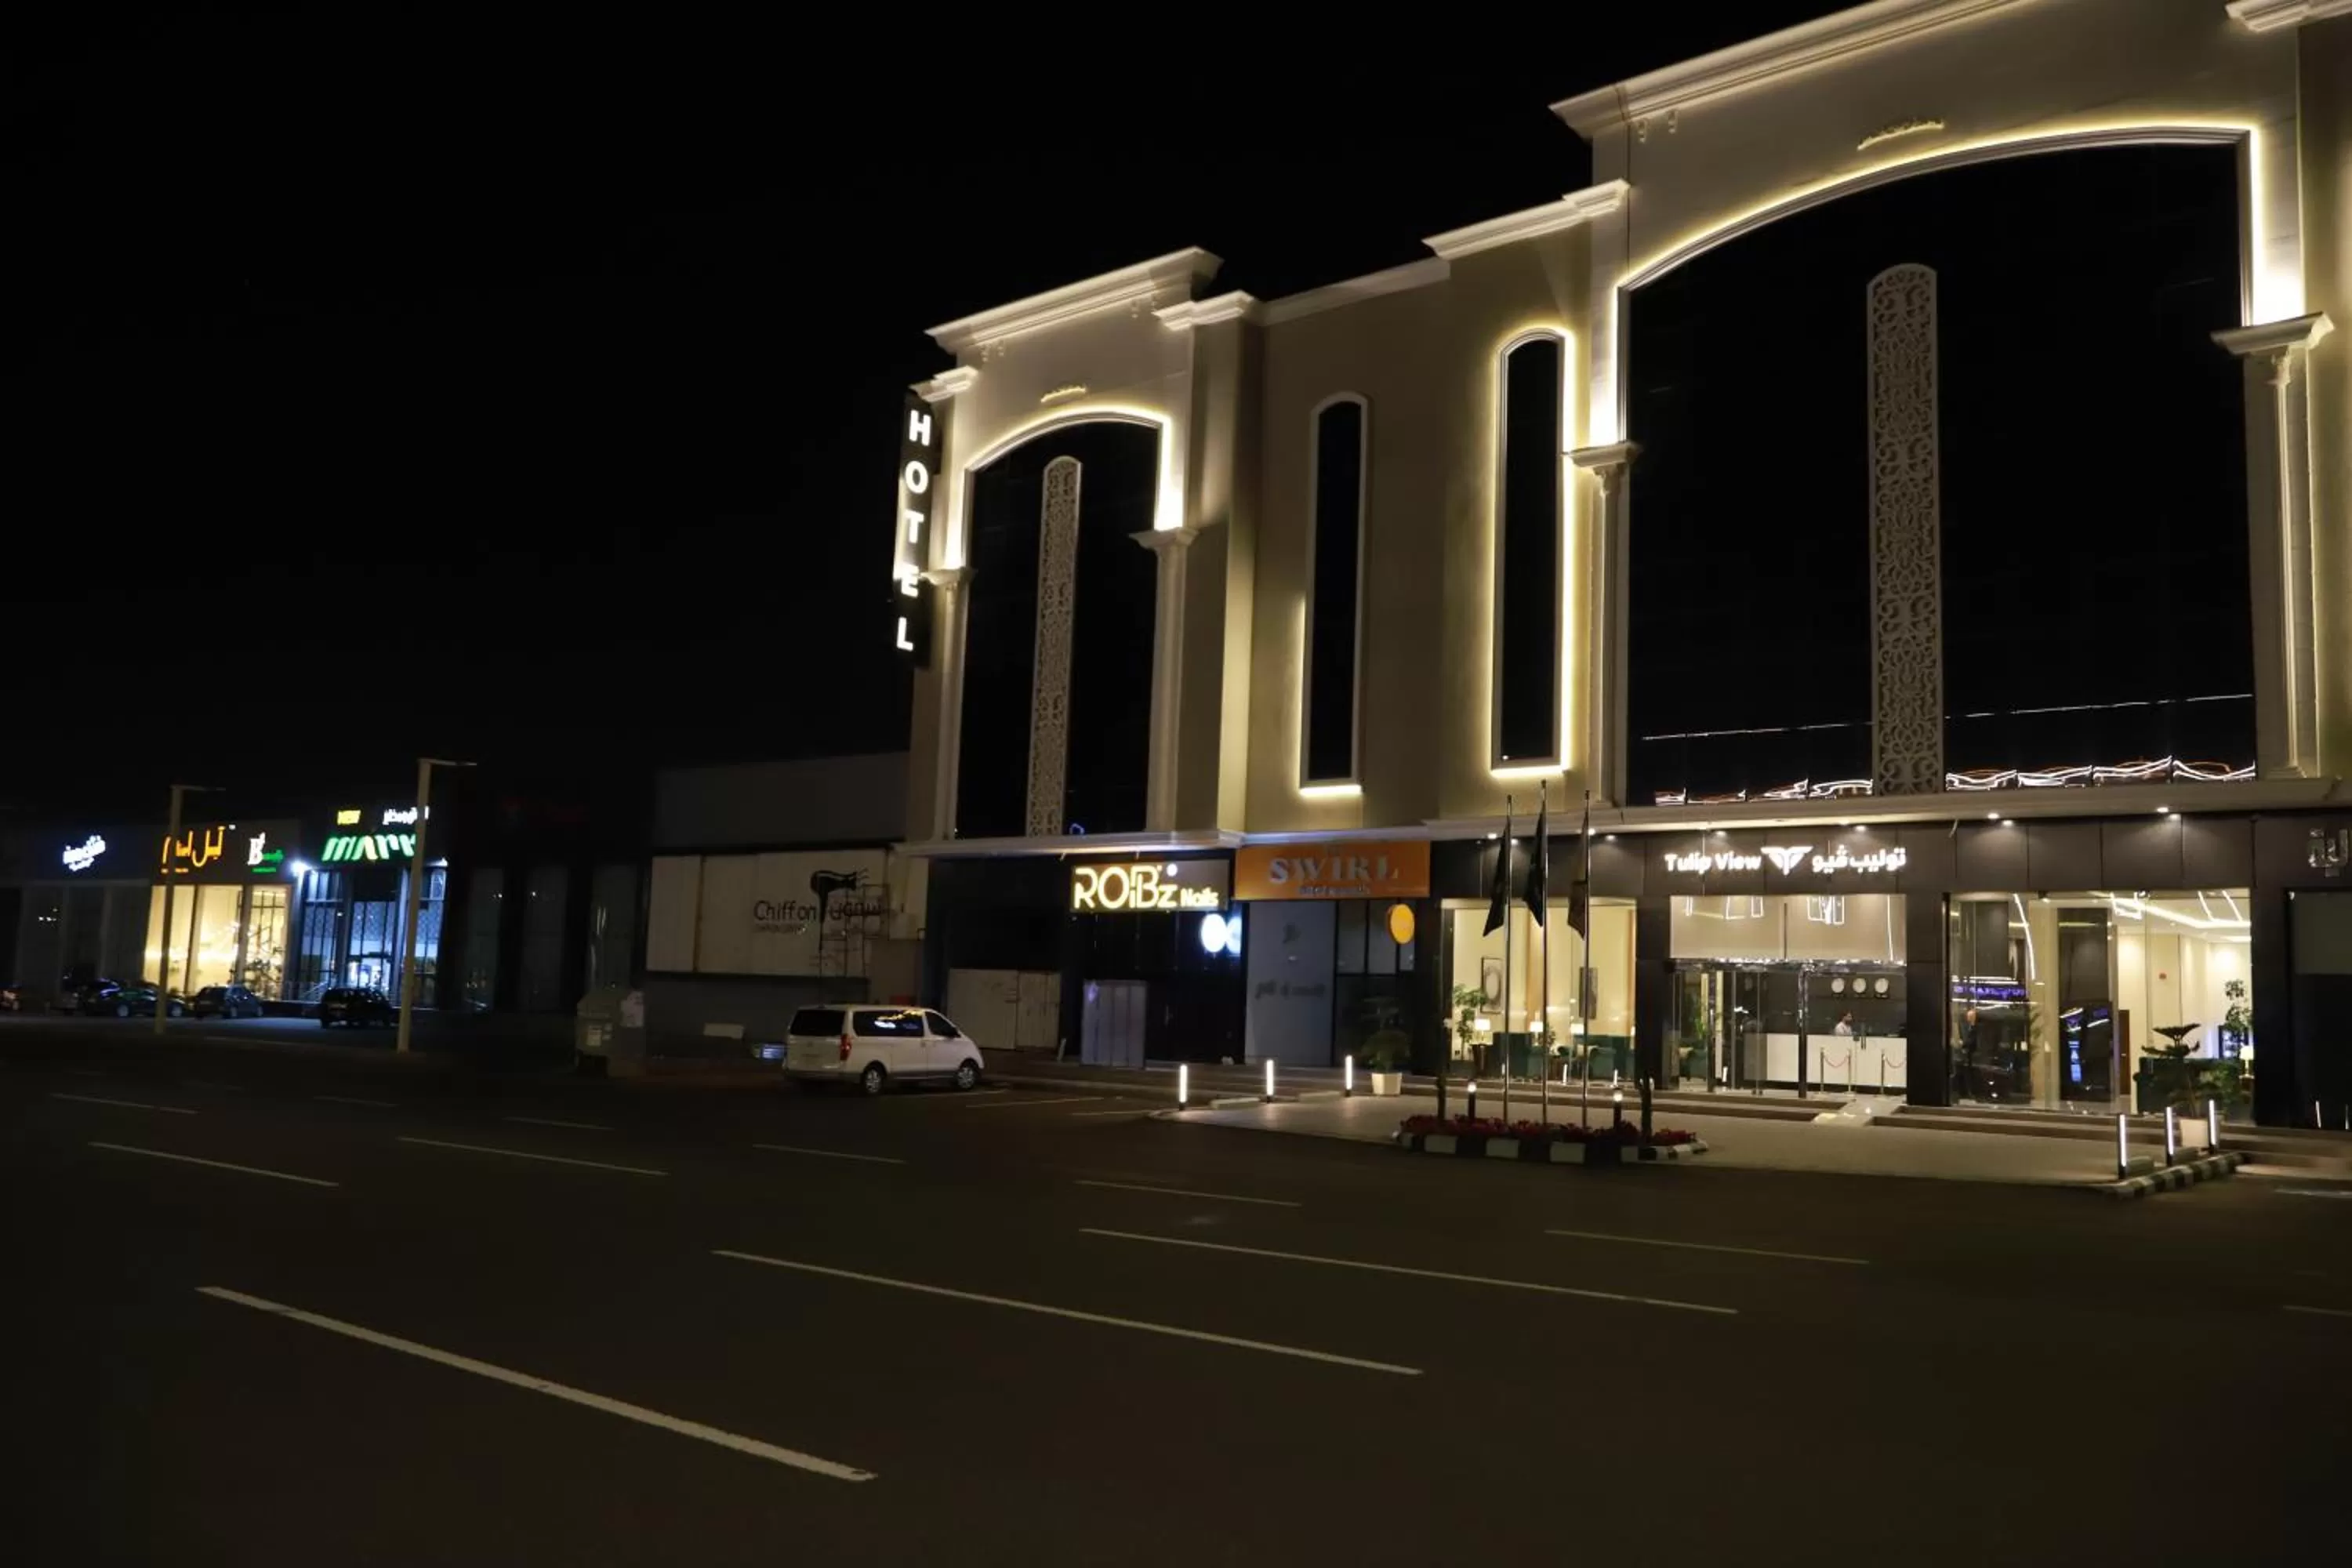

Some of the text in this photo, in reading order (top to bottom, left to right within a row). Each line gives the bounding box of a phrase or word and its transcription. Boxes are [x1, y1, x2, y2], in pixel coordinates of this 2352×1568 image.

[896, 410, 931, 651] HOTEL
[1664, 850, 1762, 875] Tulip View
[1849, 847, 1906, 873] توليب
[753, 900, 817, 922] Chiffon
